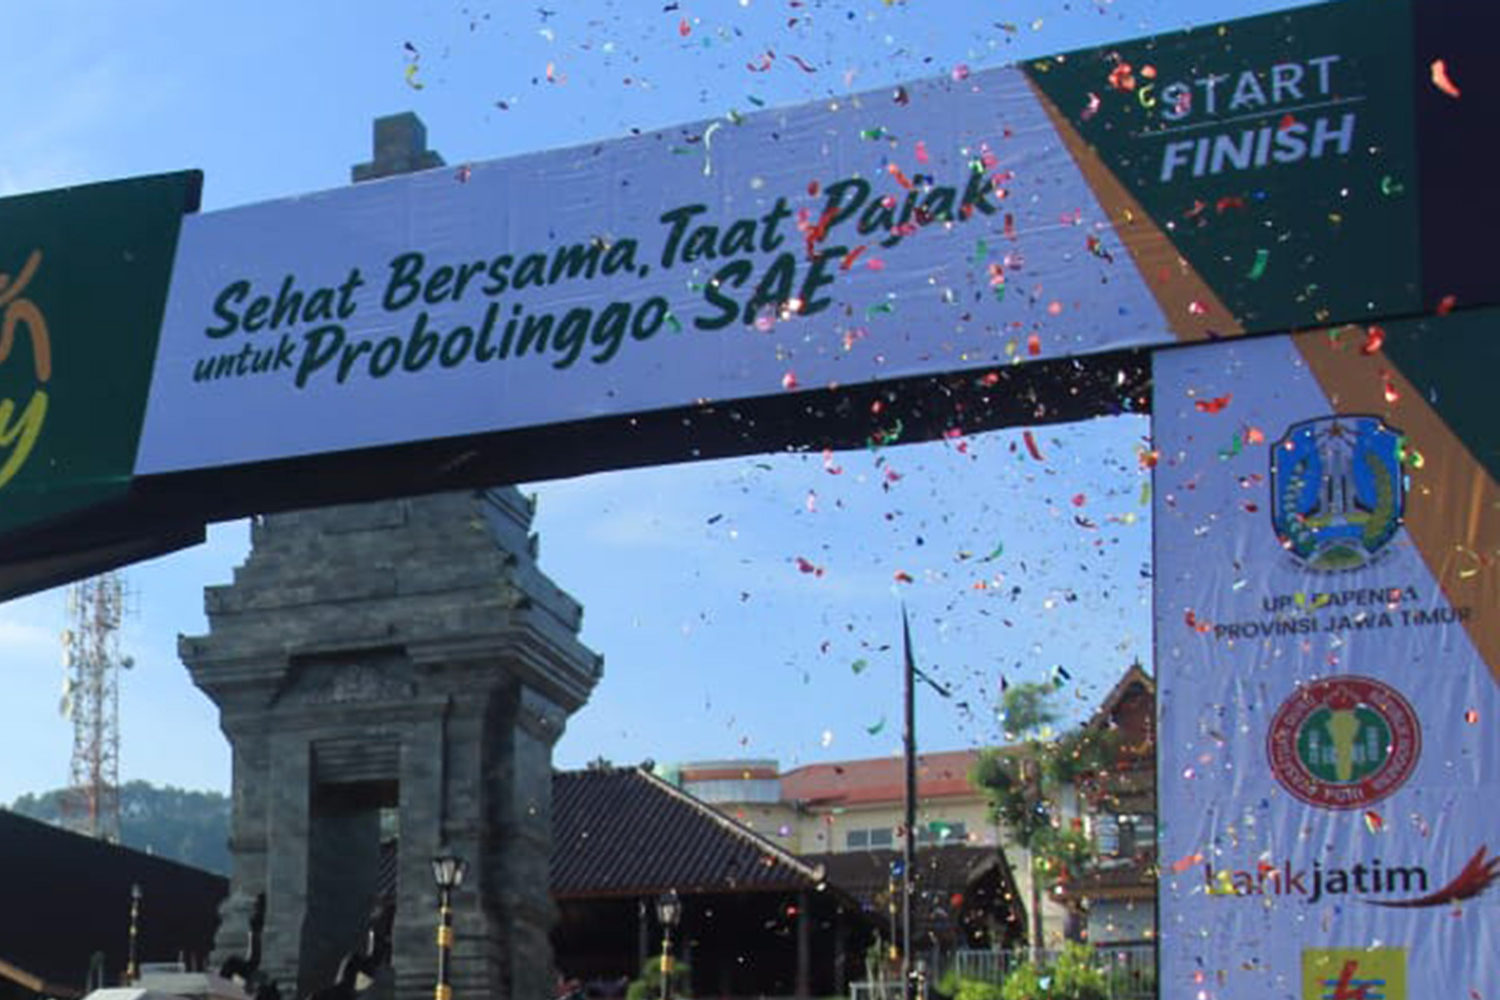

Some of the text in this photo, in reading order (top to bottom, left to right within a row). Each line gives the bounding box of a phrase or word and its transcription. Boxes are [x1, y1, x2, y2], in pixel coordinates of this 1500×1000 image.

[1160, 55, 1342, 121] START
[1160, 113, 1356, 183] FINISH
[205, 164, 998, 339] Sehat Bersama, Taat Pajak
[194, 247, 843, 390] untuk Probolinggo SAE
[1214, 605, 1472, 640] PROVINSI JAWA TIMUR
[1262, 592, 1306, 612] UP
